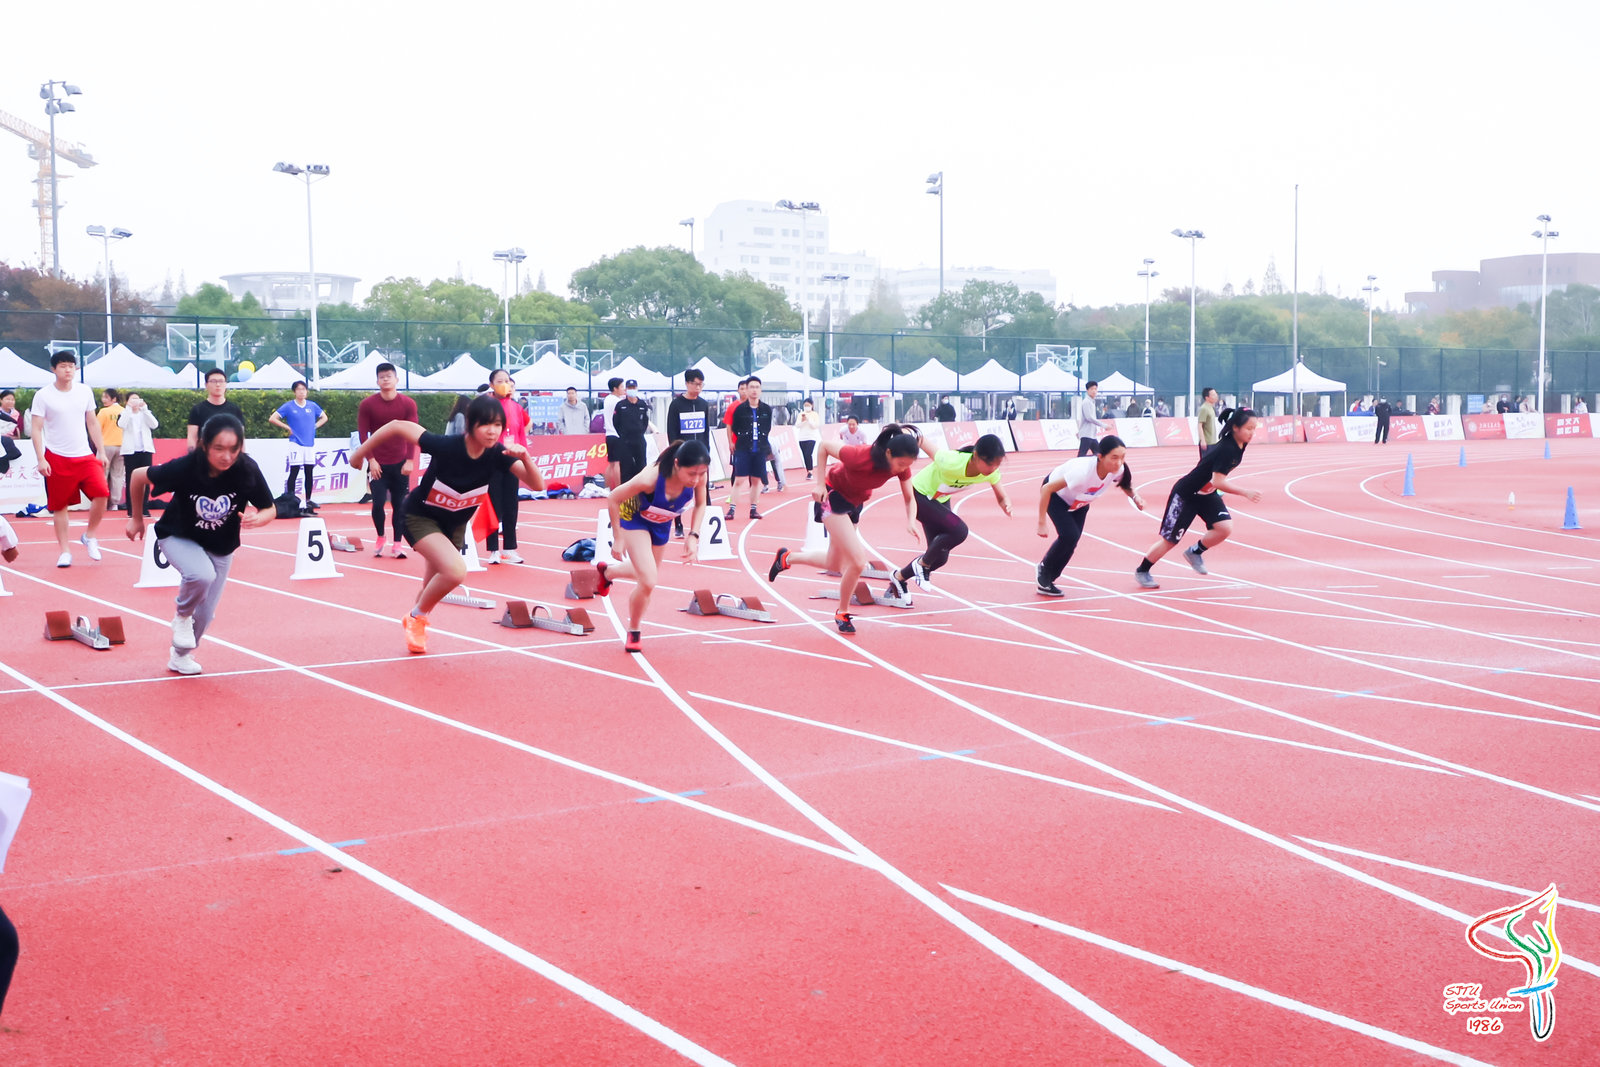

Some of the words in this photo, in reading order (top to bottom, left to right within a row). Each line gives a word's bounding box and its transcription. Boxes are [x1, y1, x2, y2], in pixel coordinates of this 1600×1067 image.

[683, 419, 704, 429] 1272
[434, 493, 478, 508] 0601
[708, 516, 723, 545] 2
[308, 529, 325, 562] 5
